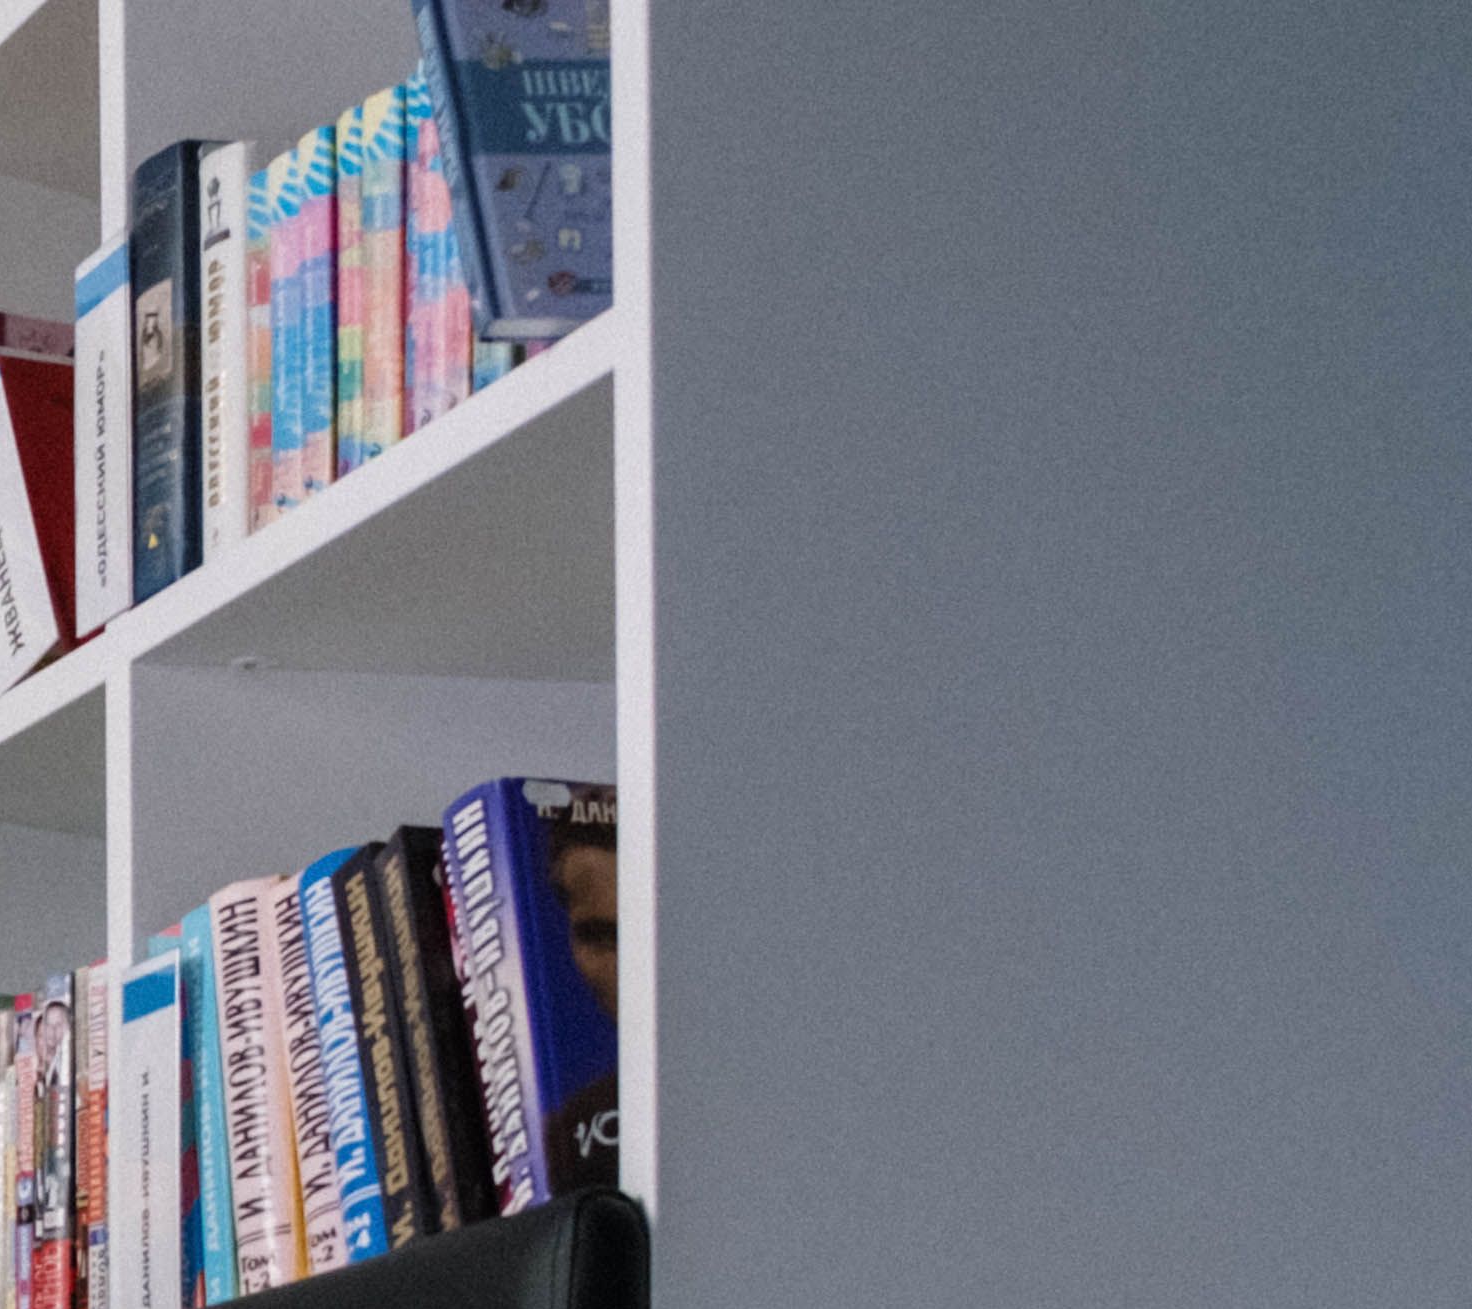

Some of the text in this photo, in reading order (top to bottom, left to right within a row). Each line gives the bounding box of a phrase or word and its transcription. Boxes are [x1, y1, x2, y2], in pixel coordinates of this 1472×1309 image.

[95, 349, 107, 589] «ОДЕССКИЙ ЮМОР»
[219, 896, 271, 1180] ДАНИЛОВ-ИВУШКИН
[274, 893, 332, 1200] И. ДАНИЛОВ-ИВУШКИН
[304, 874, 366, 1190] И. ДАНИЛОВ-ИВУШКИН
[345, 871, 411, 1197] Данилов-Ивушкин
[455, 799, 532, 1157] ДАНИЛОВ-ИВУШКИН
